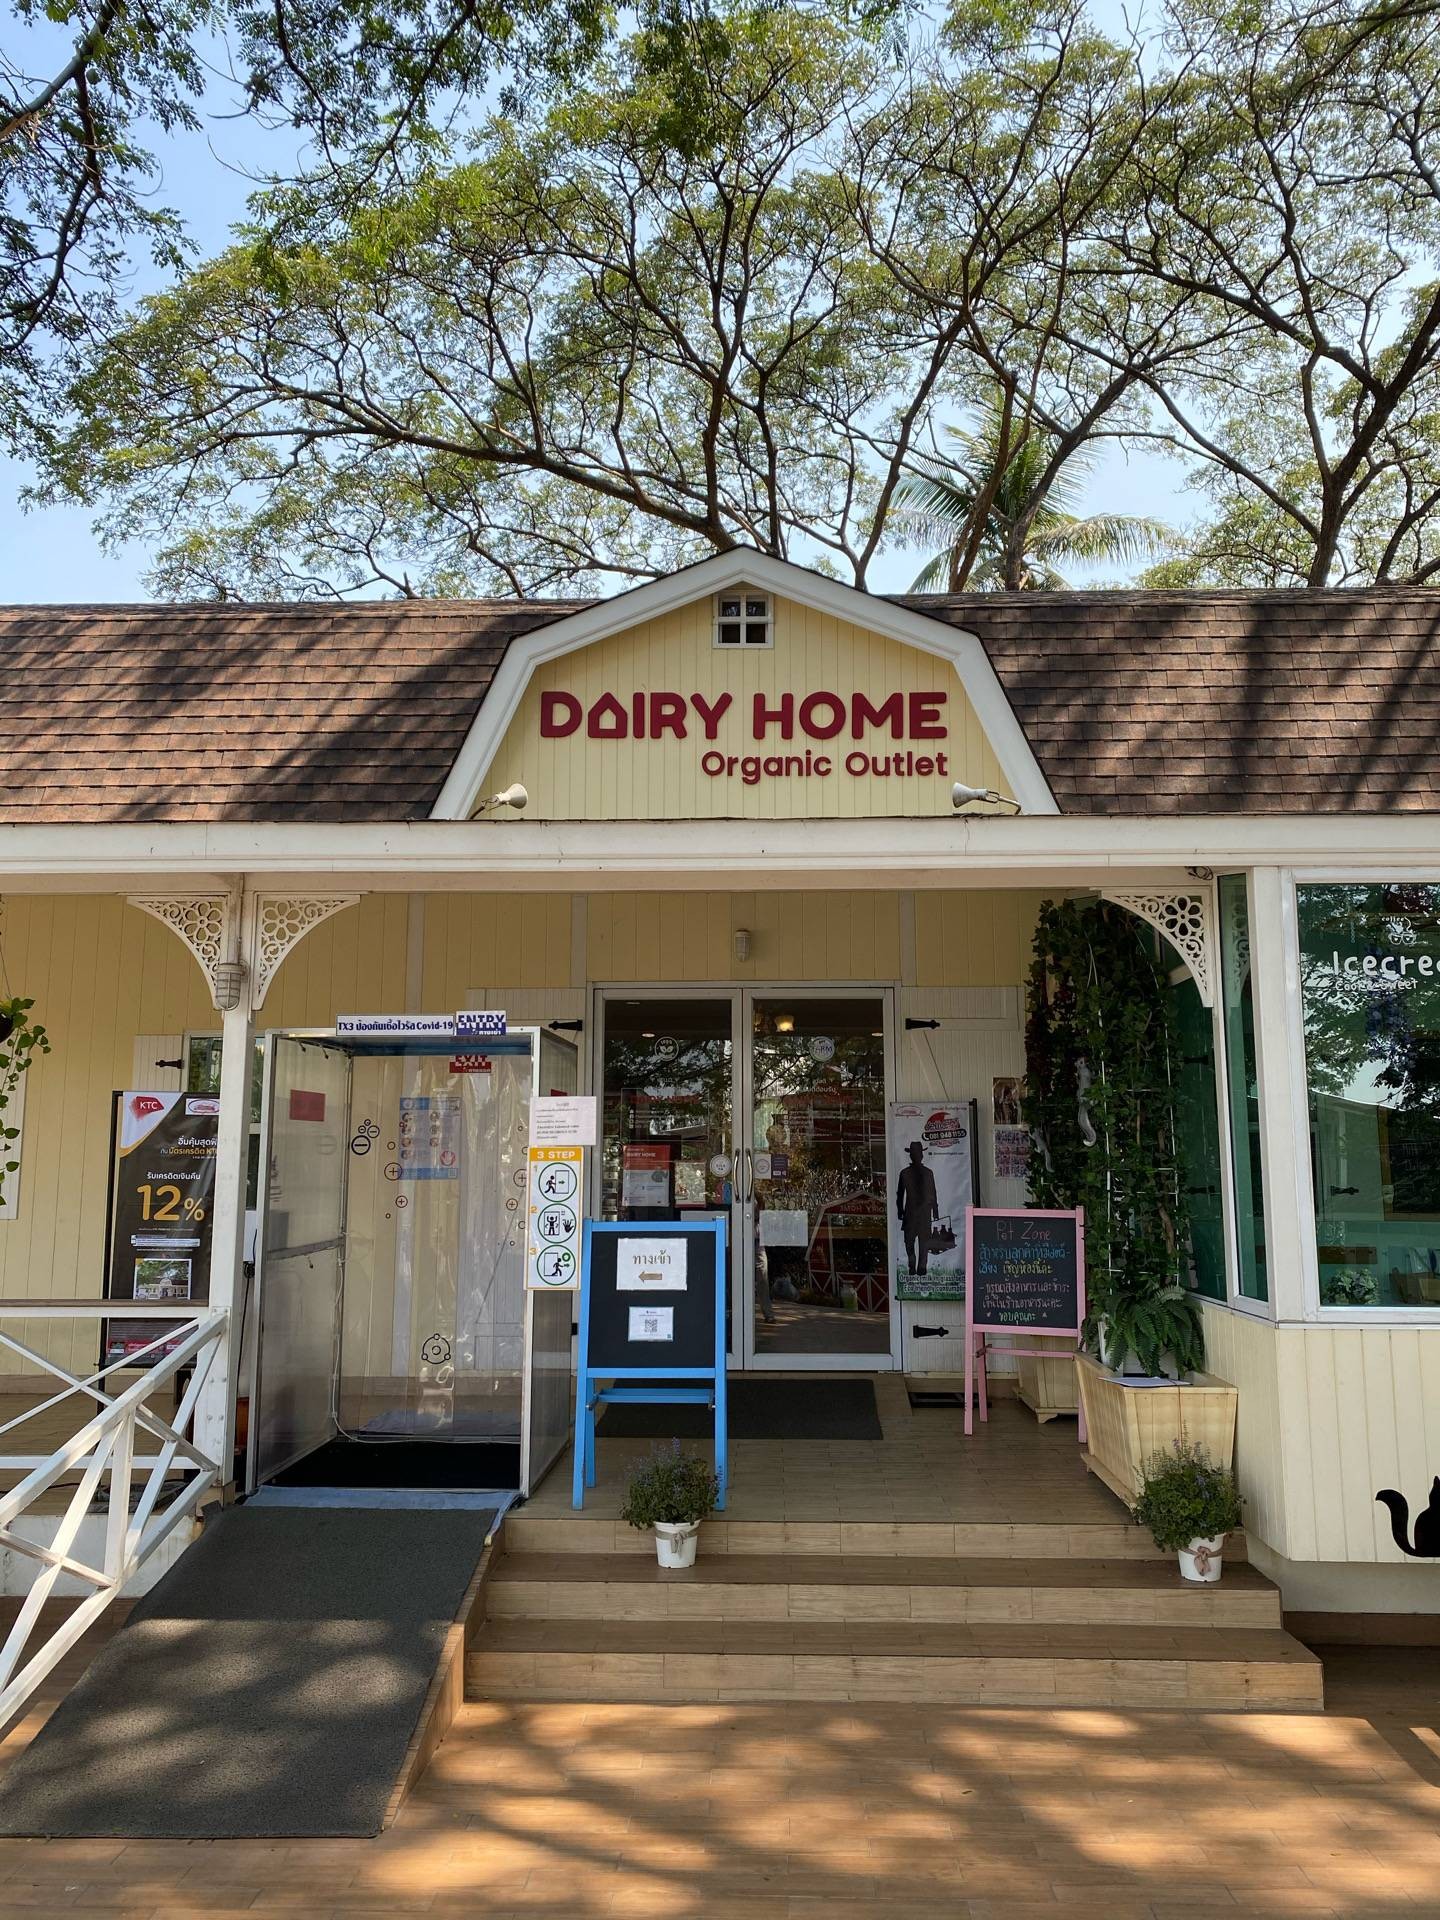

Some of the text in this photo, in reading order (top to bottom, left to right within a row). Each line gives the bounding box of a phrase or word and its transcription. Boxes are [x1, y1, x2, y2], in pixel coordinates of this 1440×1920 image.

[753, 691, 948, 740] HOME
[701, 749, 948, 785] Organic Outlet
[416, 1021, 454, 1030] Covid-19
[458, 1015, 505, 1029] ENTRY
[455, 1055, 488, 1066] EXIT
[537, 1151, 576, 1159] 3 STEP
[529, 1206, 537, 1214] 2
[996, 1220, 1051, 1240] Pet Zone
[529, 1247, 537, 1255] 3
[632, 1249, 671, 1264] ทางเข้า
